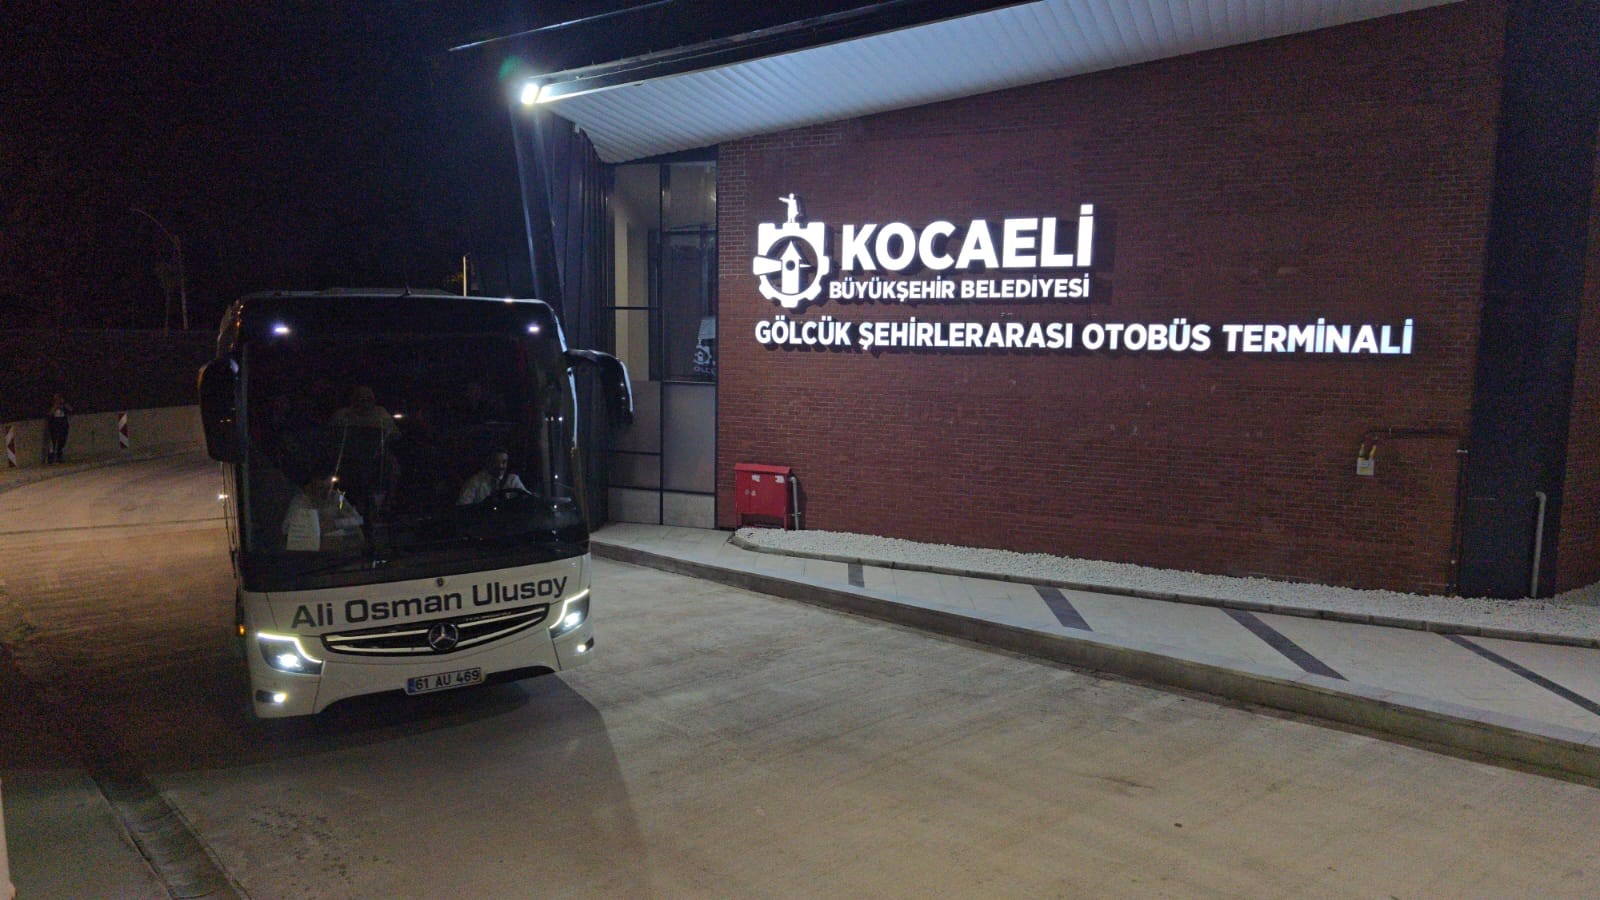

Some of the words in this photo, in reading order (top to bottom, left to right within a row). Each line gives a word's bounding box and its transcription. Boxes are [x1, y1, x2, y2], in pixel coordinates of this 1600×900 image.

[841, 204, 1094, 271] KOCAELİ
[829, 276, 955, 302] BÜYÜKŞEHİR
[960, 273, 1090, 299] BELEDİYESİ
[755, 315, 852, 346] GÖLCÜK
[858, 316, 1074, 351] ŞEHİRLERARASI
[1081, 318, 1211, 352] OTOBÜS
[1222, 318, 1413, 355] TERMİNALİ
[291, 602, 333, 628] Ali
[345, 591, 462, 623] Osman
[472, 576, 567, 606] Ulusoy
[415, 679, 429, 690] 61
[435, 674, 452, 688] AU
[456, 670, 480, 682] 469
